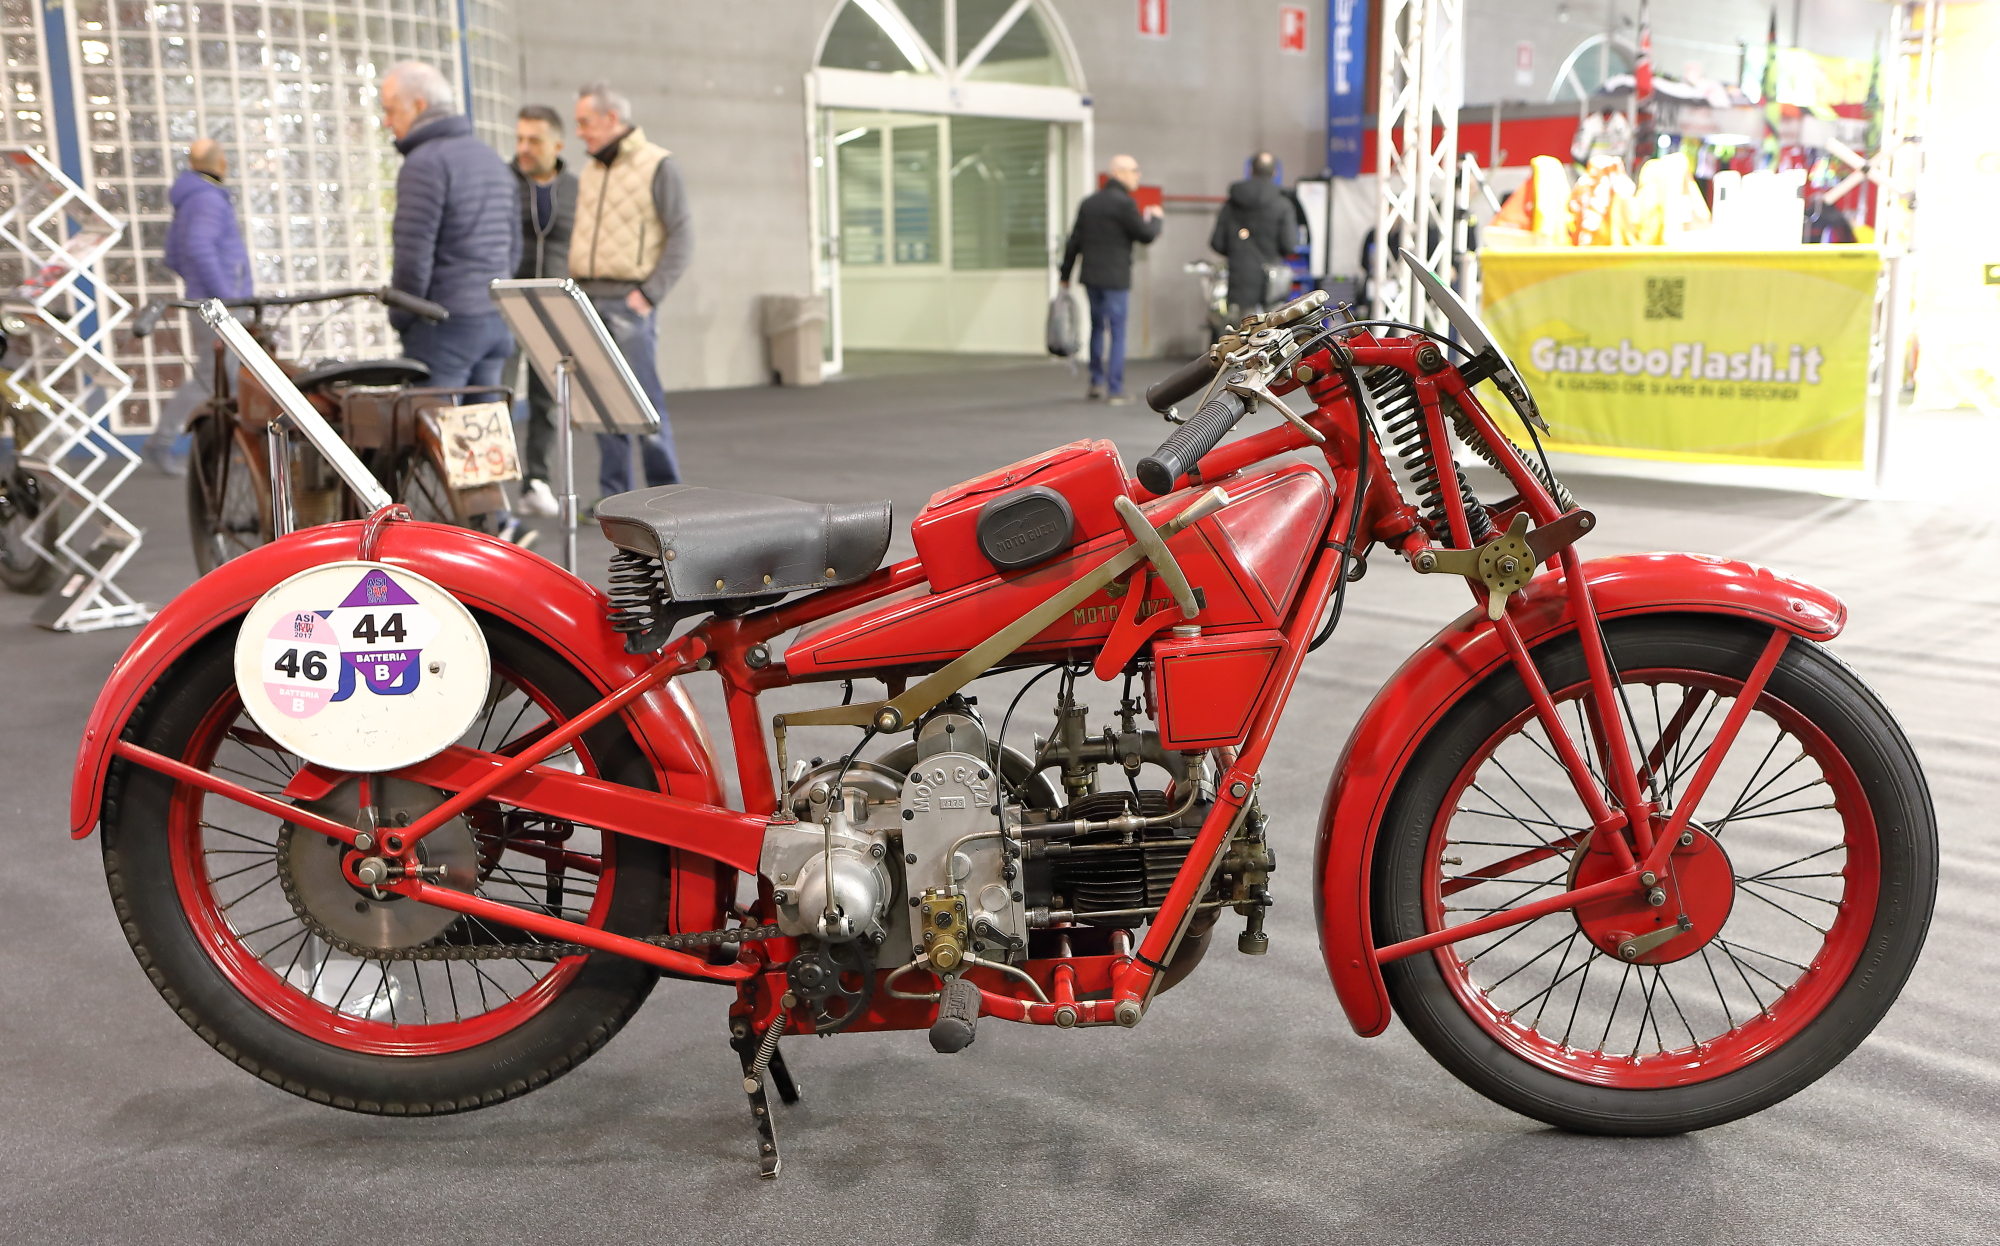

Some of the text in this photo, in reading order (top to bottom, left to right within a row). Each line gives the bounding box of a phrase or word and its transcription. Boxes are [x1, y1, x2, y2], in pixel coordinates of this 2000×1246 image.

[1530, 337, 1824, 385] GazeboFlash.it
[996, 520, 1058, 553] MOTO GUZZI
[366, 577, 387, 587] ASI
[295, 613, 314, 623] ASI
[1073, 604, 1119, 626] MOTO
[294, 631, 312, 639] 2017
[352, 612, 407, 644] 44
[274, 647, 328, 681] 46
[356, 652, 407, 663] BATTERIA
[374, 664, 390, 682] B
[279, 688, 320, 700] BATTERIA
[292, 699, 305, 713] B
[913, 766, 991, 812] MOTO GUZZI
